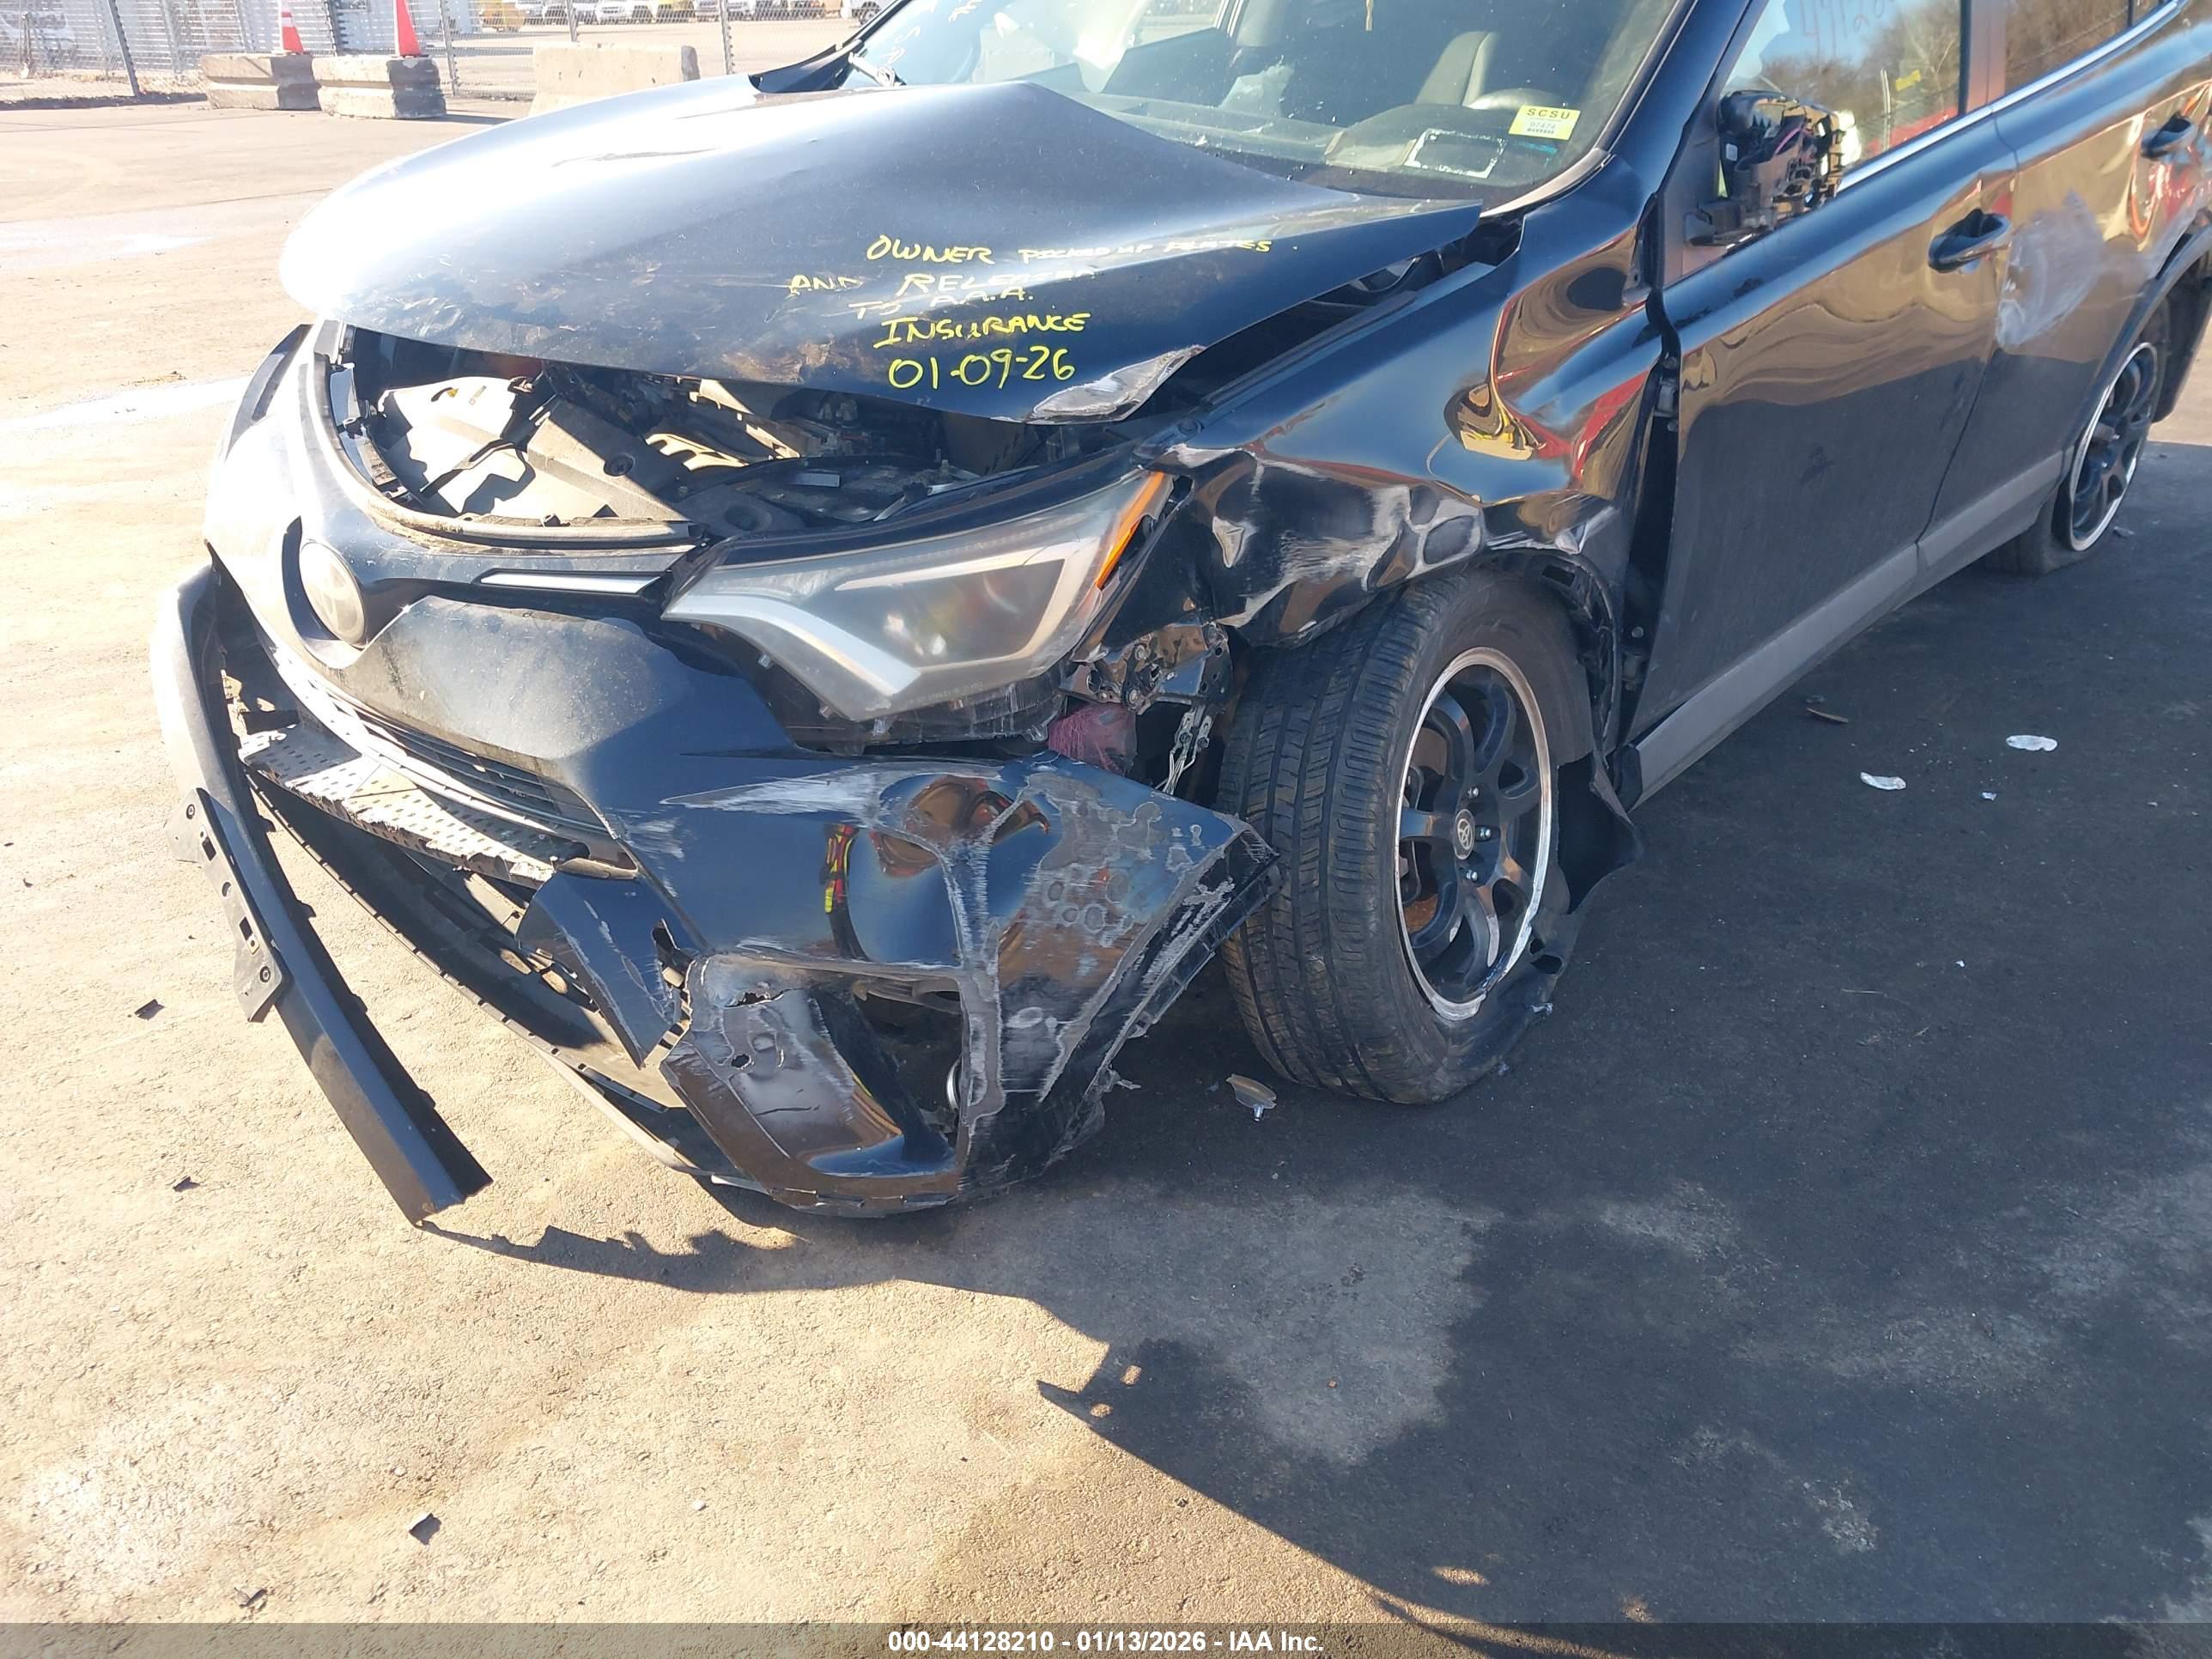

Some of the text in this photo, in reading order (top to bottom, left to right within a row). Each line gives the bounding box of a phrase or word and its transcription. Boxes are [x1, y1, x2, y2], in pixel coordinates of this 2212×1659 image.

[1526, 108, 1571, 119] SCSU
[866, 234, 995, 265] OWNER
[787, 274, 864, 296] AND
[848, 301, 900, 319] TO
[873, 313, 1091, 349] INSURANCE
[888, 345, 1076, 391] 01-09-26
